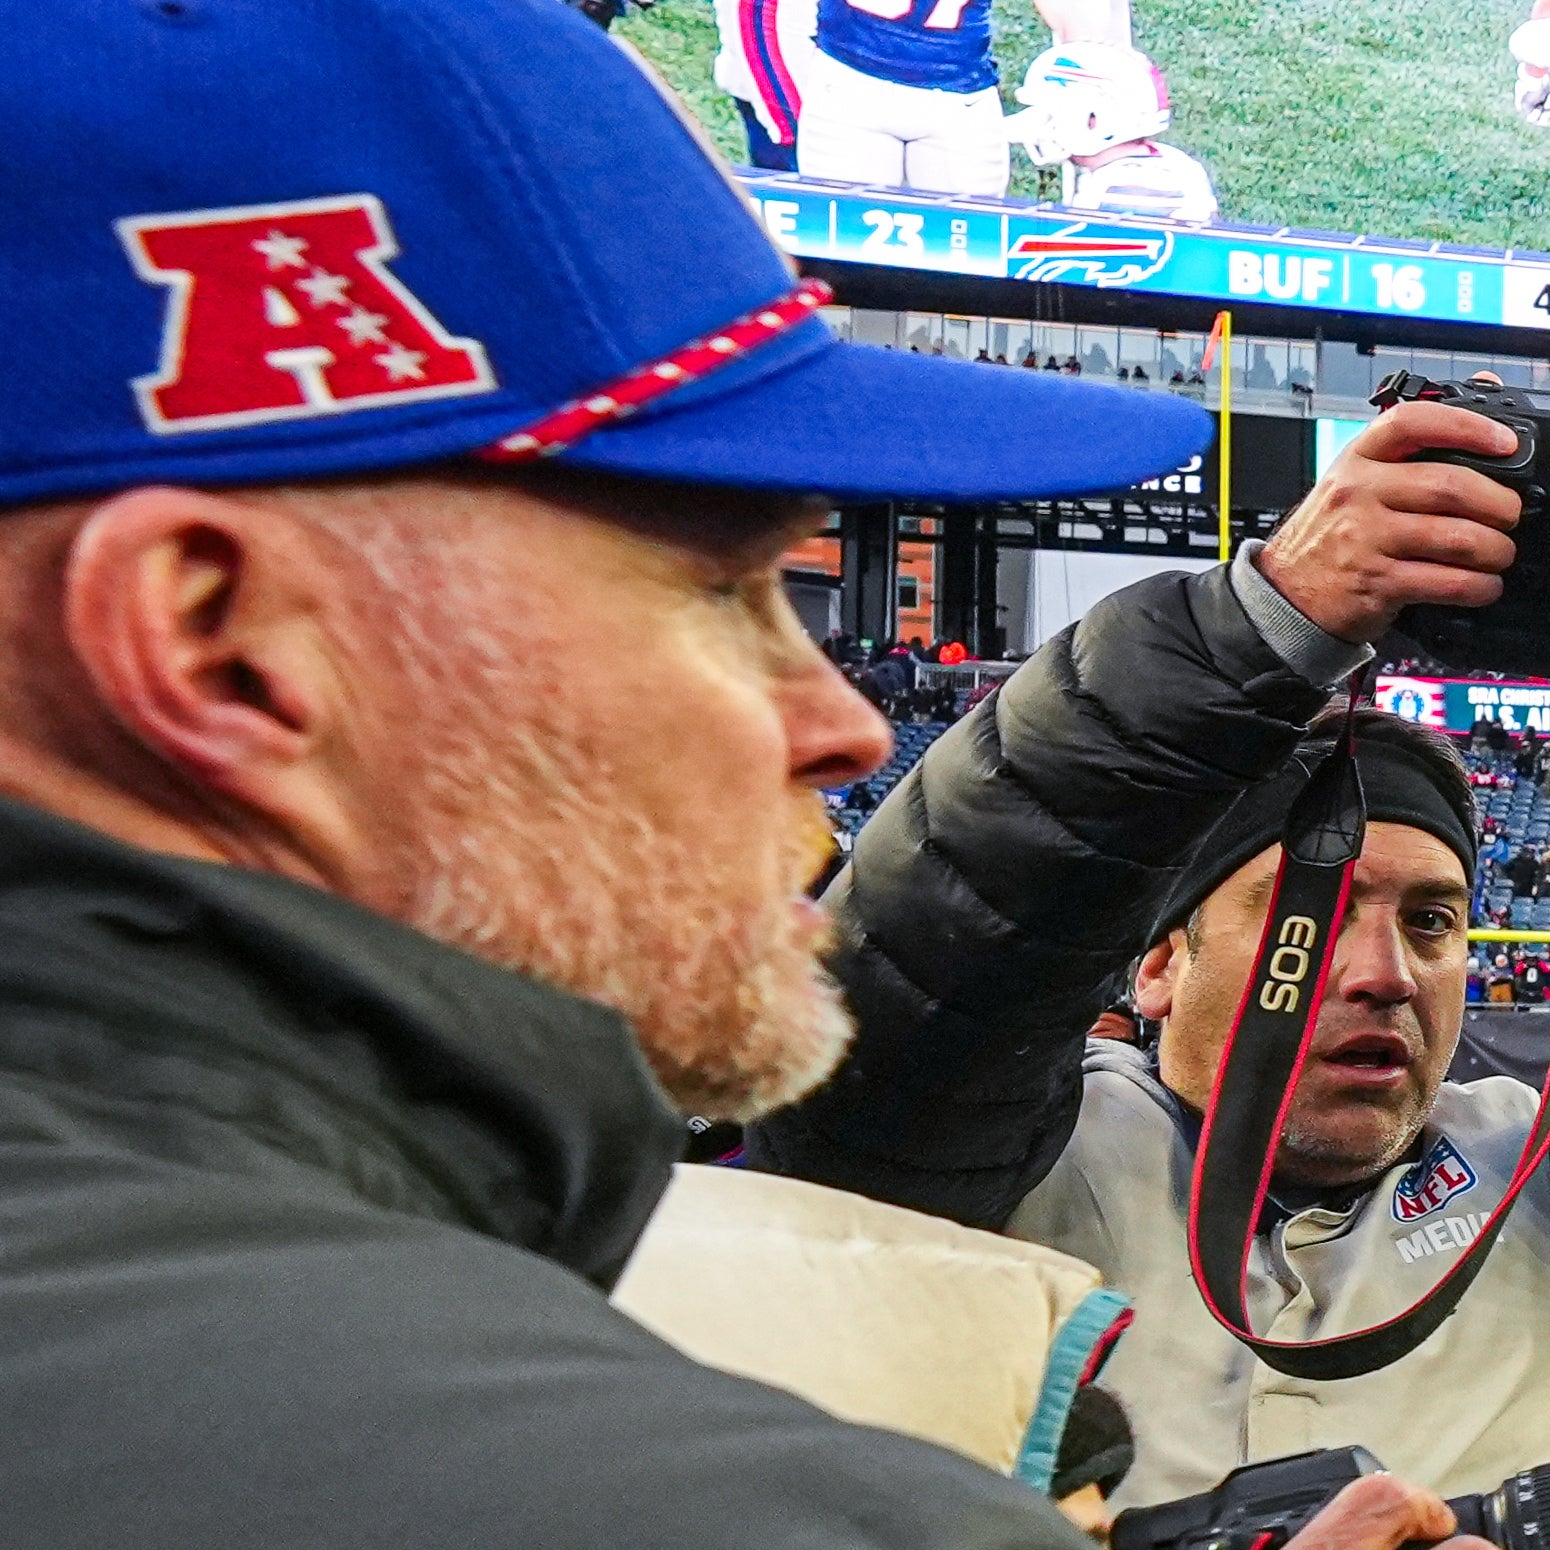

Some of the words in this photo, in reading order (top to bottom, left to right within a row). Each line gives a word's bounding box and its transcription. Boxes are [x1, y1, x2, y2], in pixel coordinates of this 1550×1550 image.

[748, 198, 801, 252] E
[862, 208, 925, 255] 23
[1228, 250, 1336, 302] BUF
[1371, 262, 1427, 312] 16
[114, 193, 498, 434] A
[1259, 914, 1318, 1014] EOS
[1398, 1163, 1468, 1219] NFL
